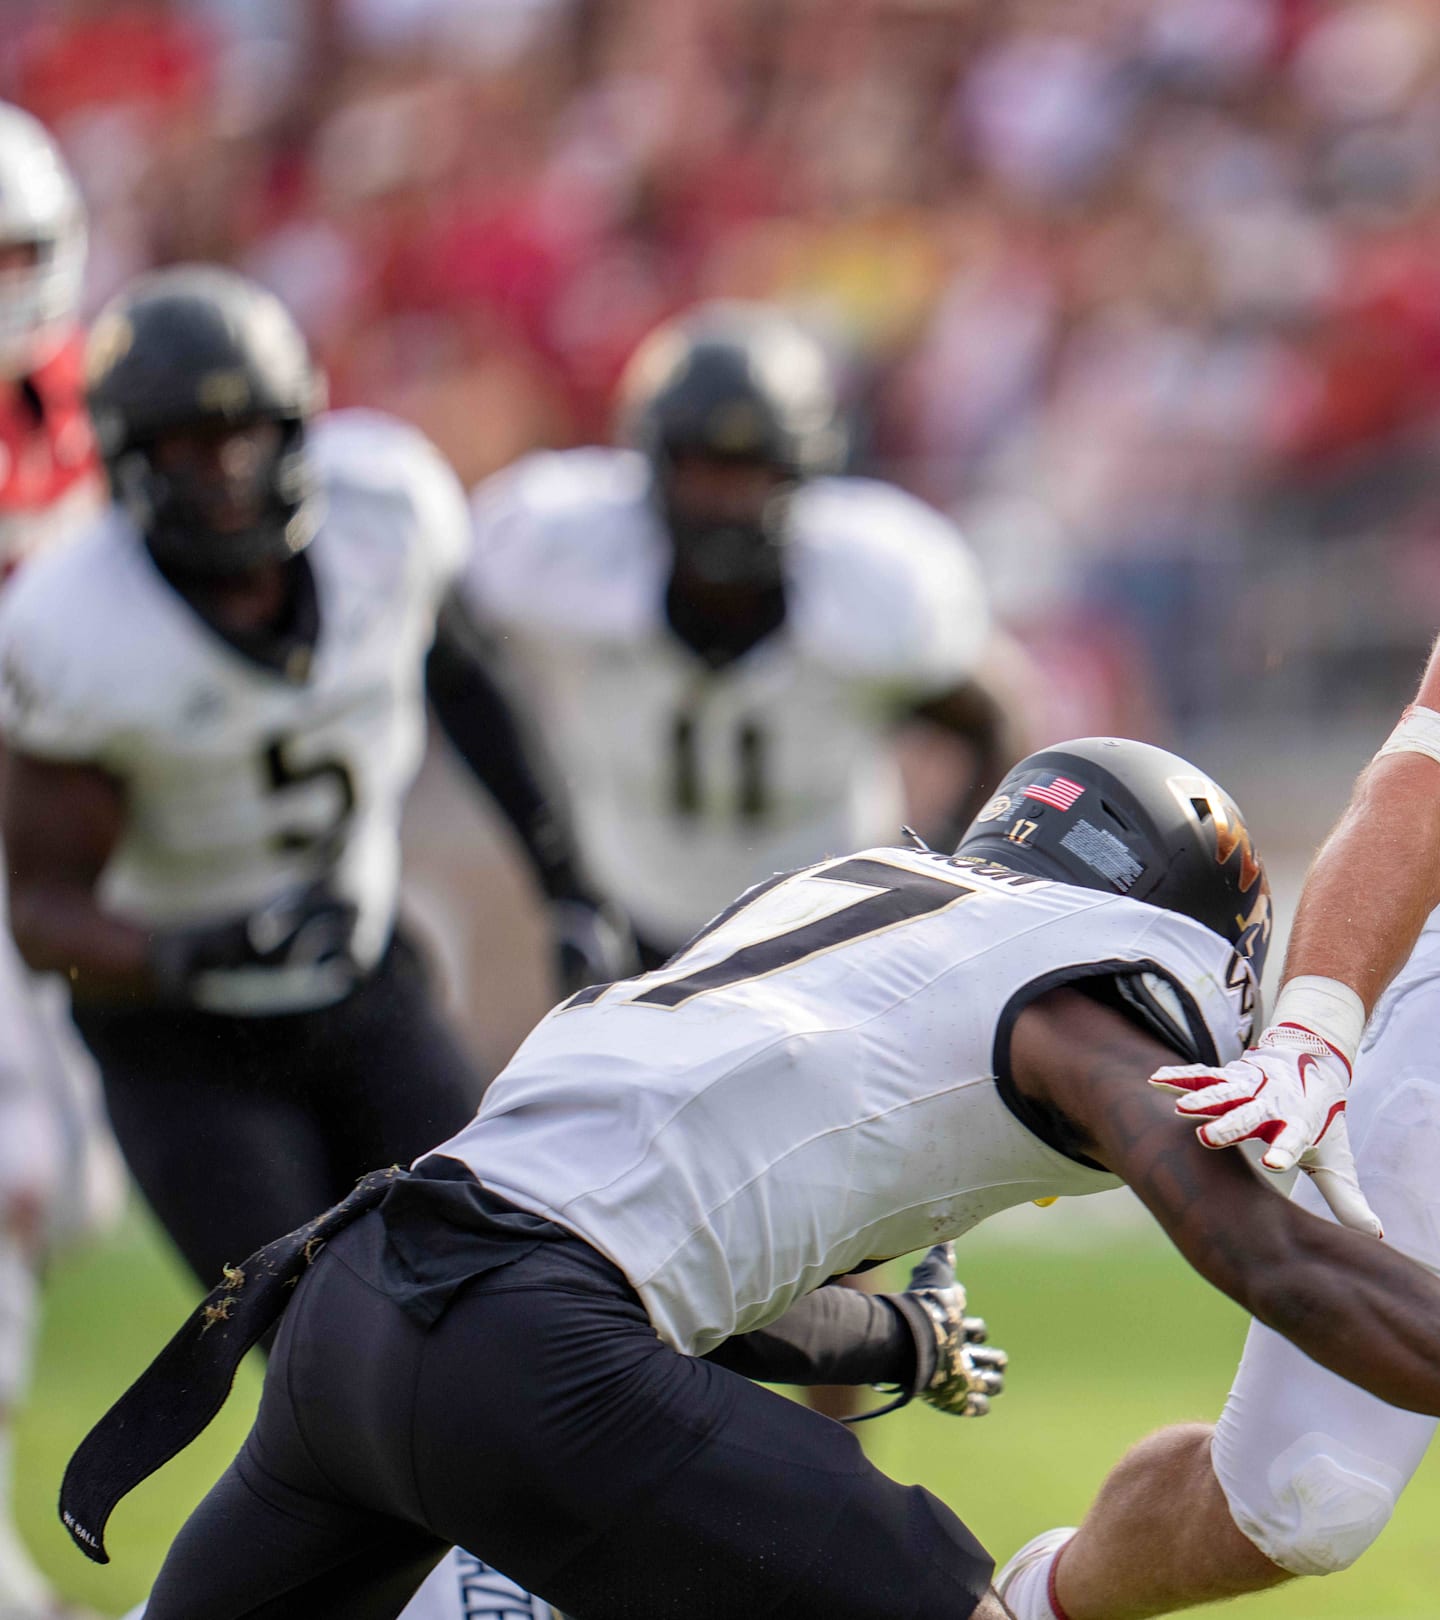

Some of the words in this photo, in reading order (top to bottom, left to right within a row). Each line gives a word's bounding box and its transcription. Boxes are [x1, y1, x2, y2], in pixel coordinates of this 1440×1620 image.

[263, 733, 354, 852] 5
[668, 712, 764, 818] 11
[1008, 818, 1038, 844] 17
